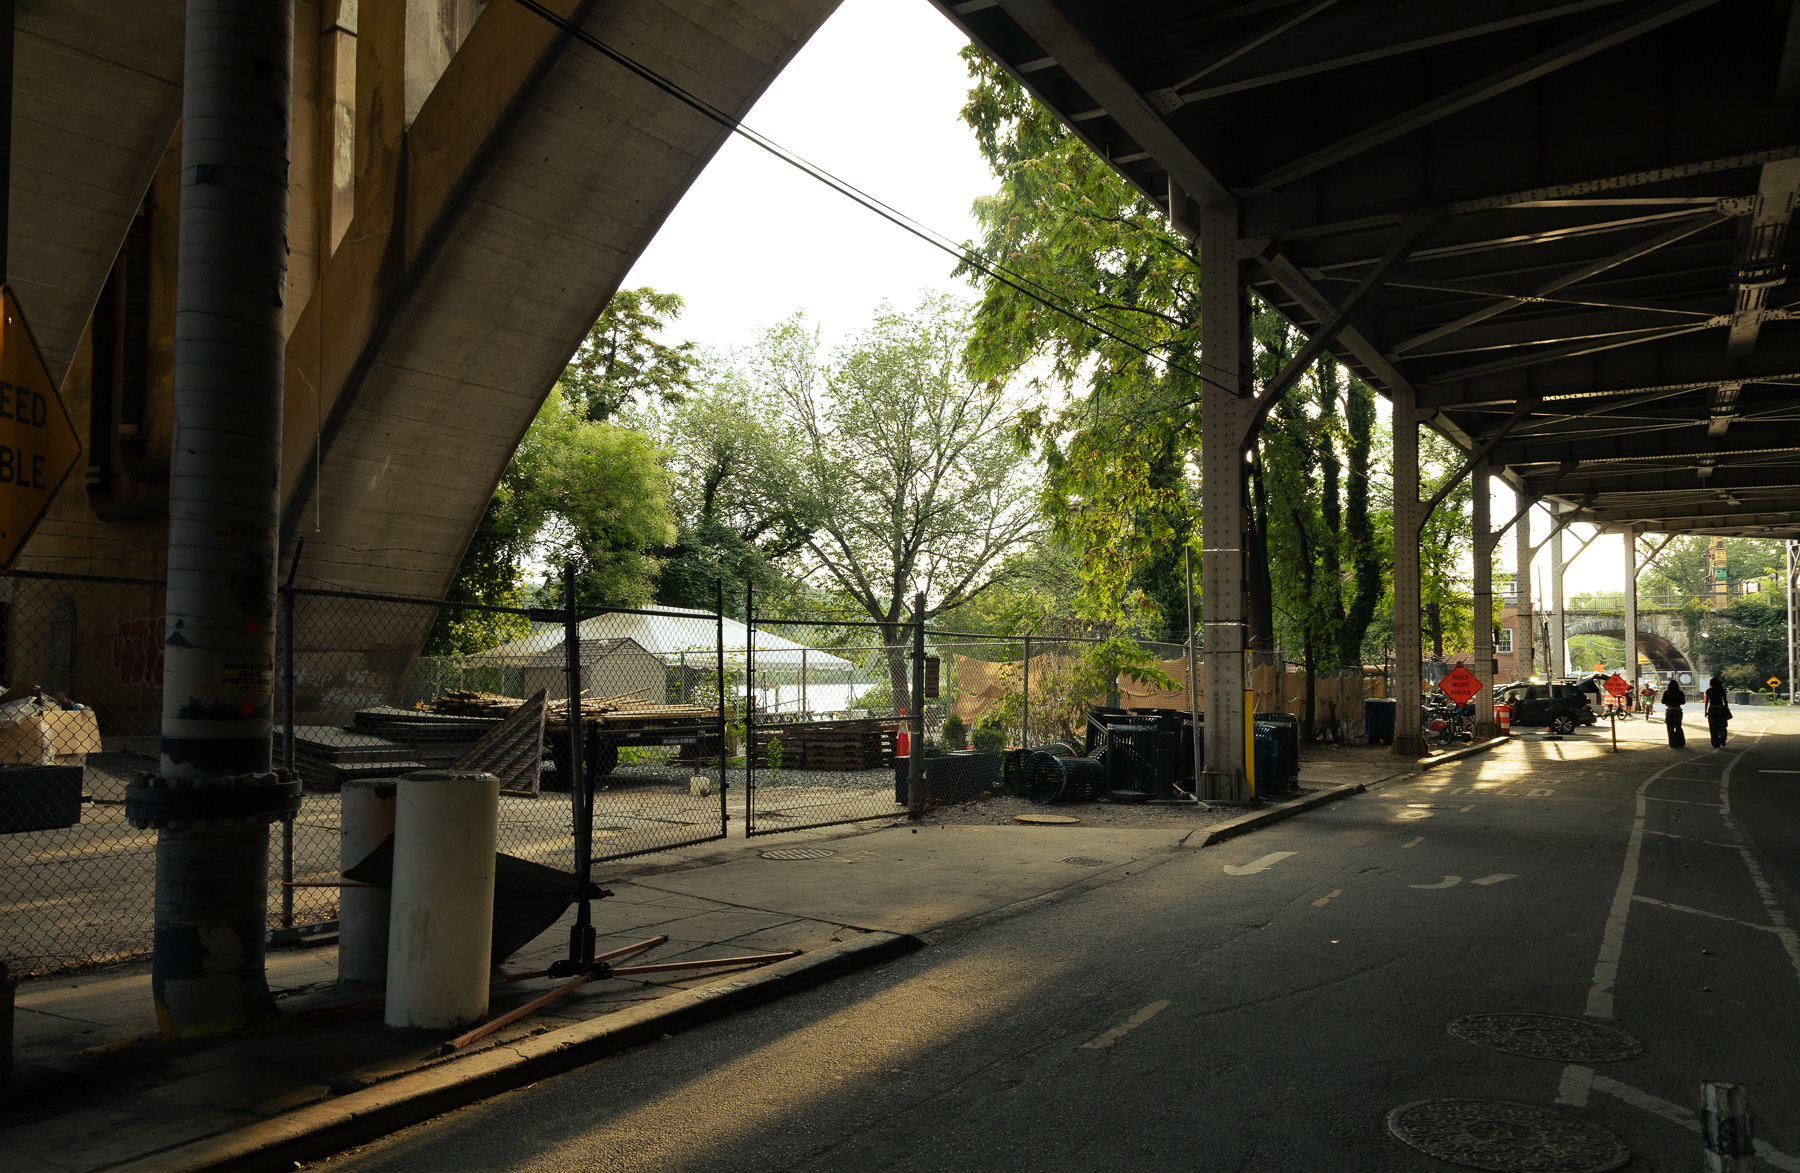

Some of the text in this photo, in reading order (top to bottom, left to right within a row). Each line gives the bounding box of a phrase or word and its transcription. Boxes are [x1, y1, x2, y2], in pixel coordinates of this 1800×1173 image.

[229, 523, 268, 534] CAUTION
[216, 530, 273, 542] GAS PIPELINE
[221, 662, 273, 671] WARNING
[239, 670, 262, 678] GAS
[221, 677, 270, 685] PIPELINE
